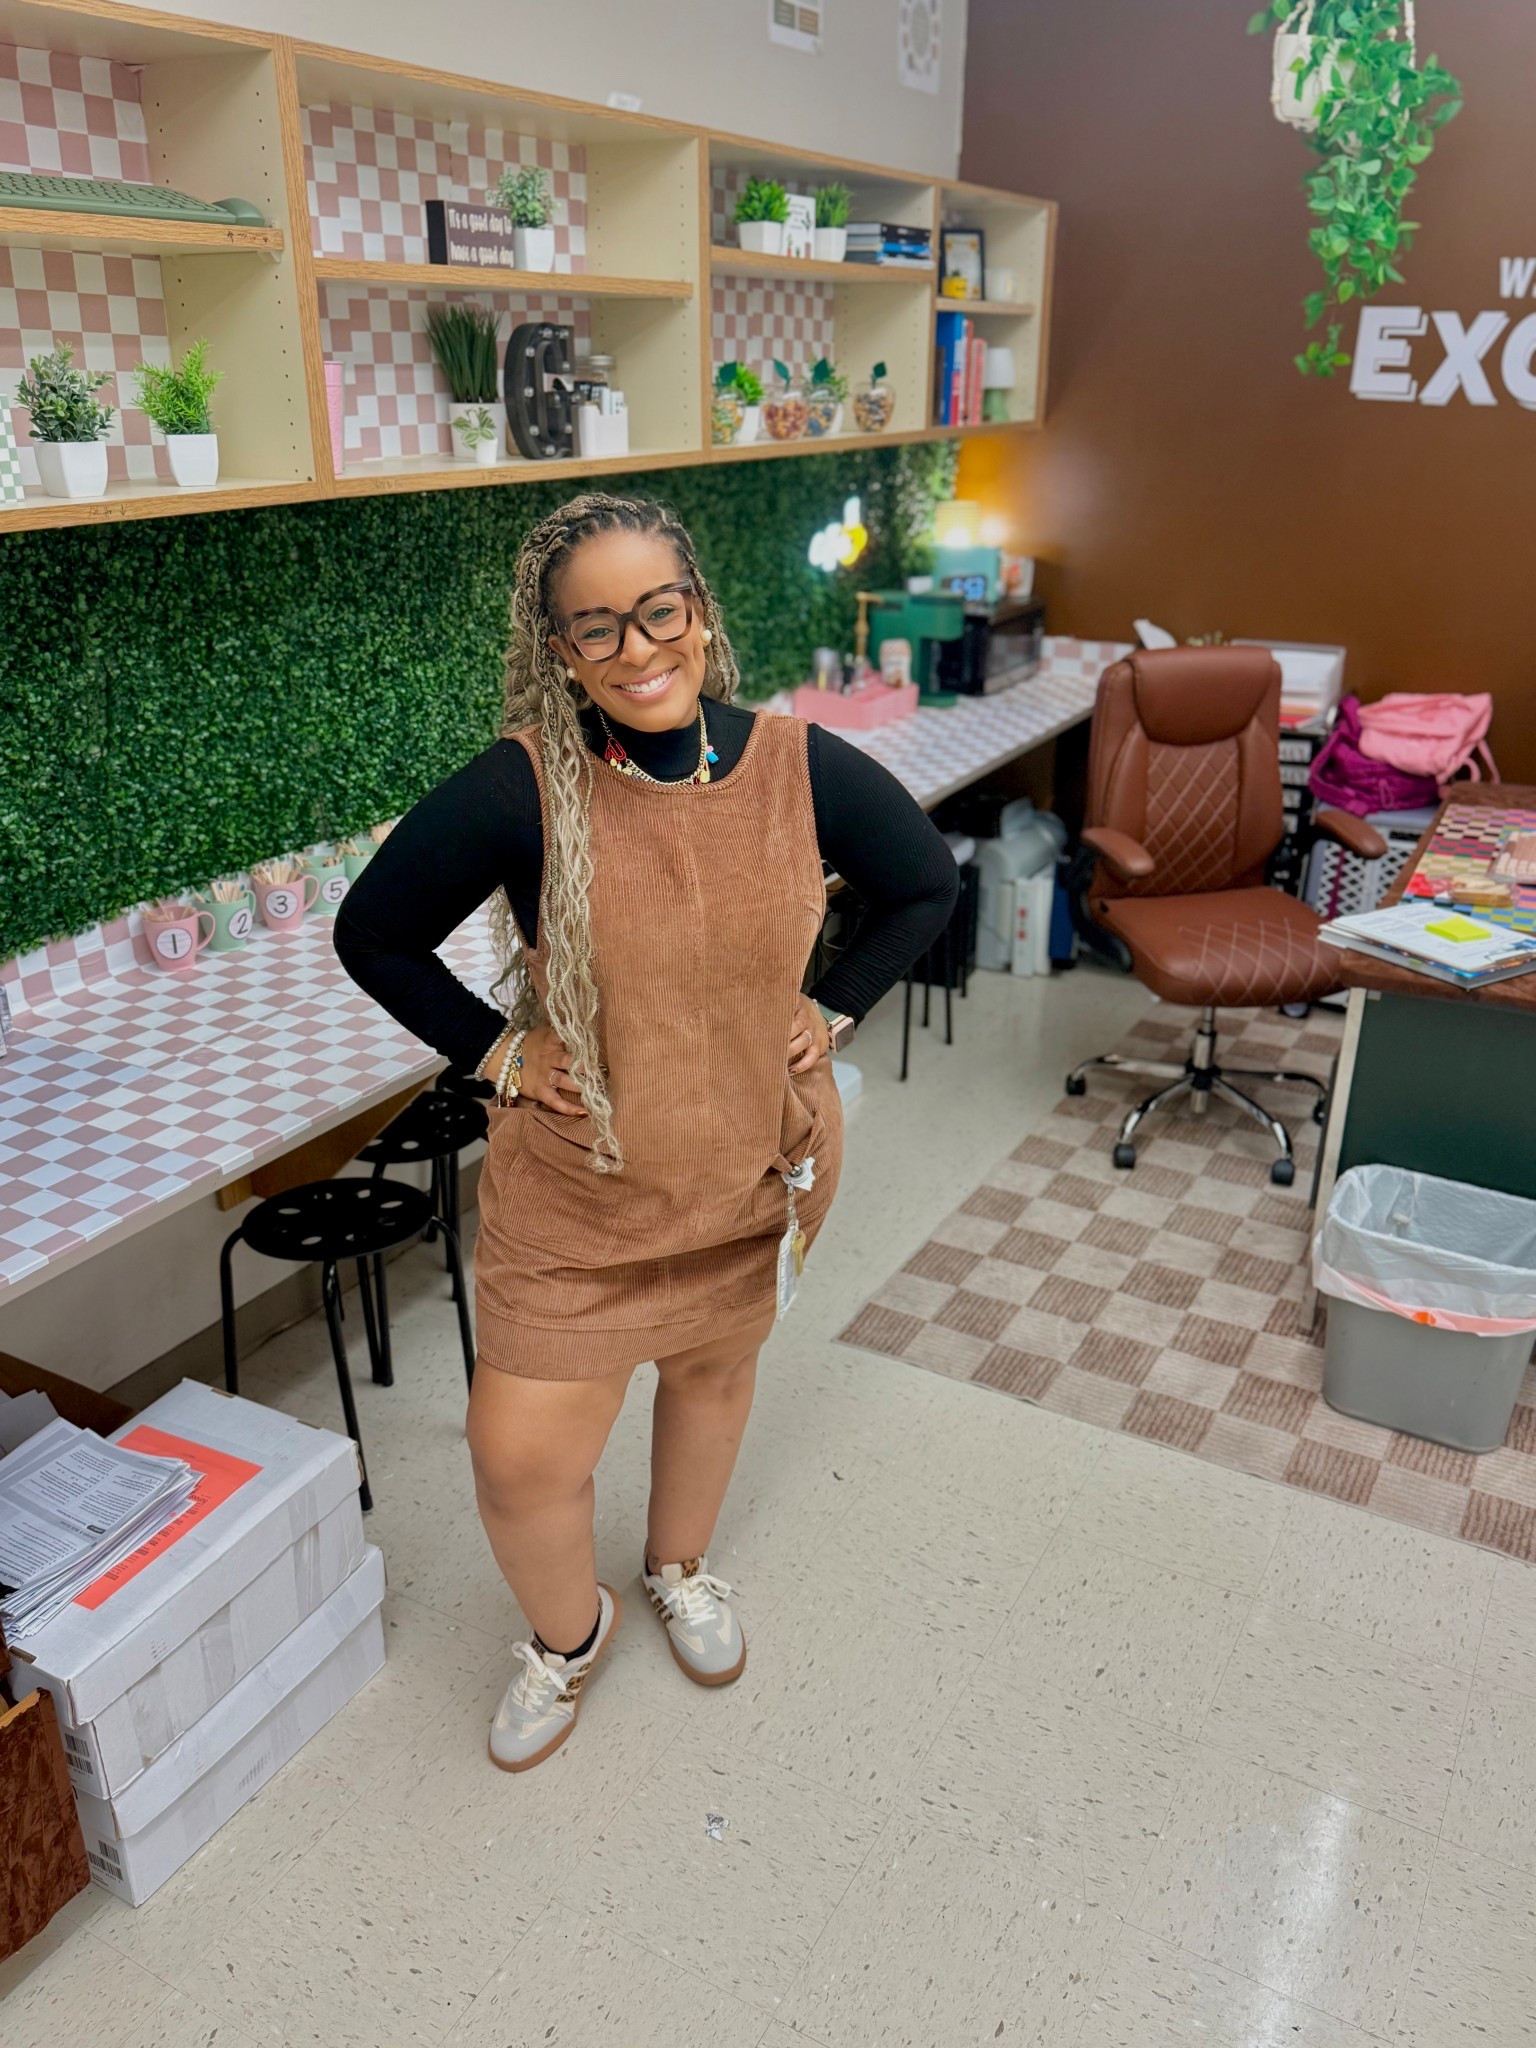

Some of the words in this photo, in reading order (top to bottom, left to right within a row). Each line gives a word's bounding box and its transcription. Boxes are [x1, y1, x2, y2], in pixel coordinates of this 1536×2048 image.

[462, 213, 468, 230] a
[469, 212, 488, 233] good
[490, 213, 503, 236] day
[503, 215, 512, 235] to
[450, 241, 470, 262] have
[471, 246, 478, 263] a
[479, 245, 498, 266] good
[500, 246, 514, 268] day
[1499, 256, 1536, 299] W
[329, 880, 344, 901] 5
[272, 895, 289, 914] 3
[236, 913, 249, 935] 2
[171, 933, 178, 954] 1
